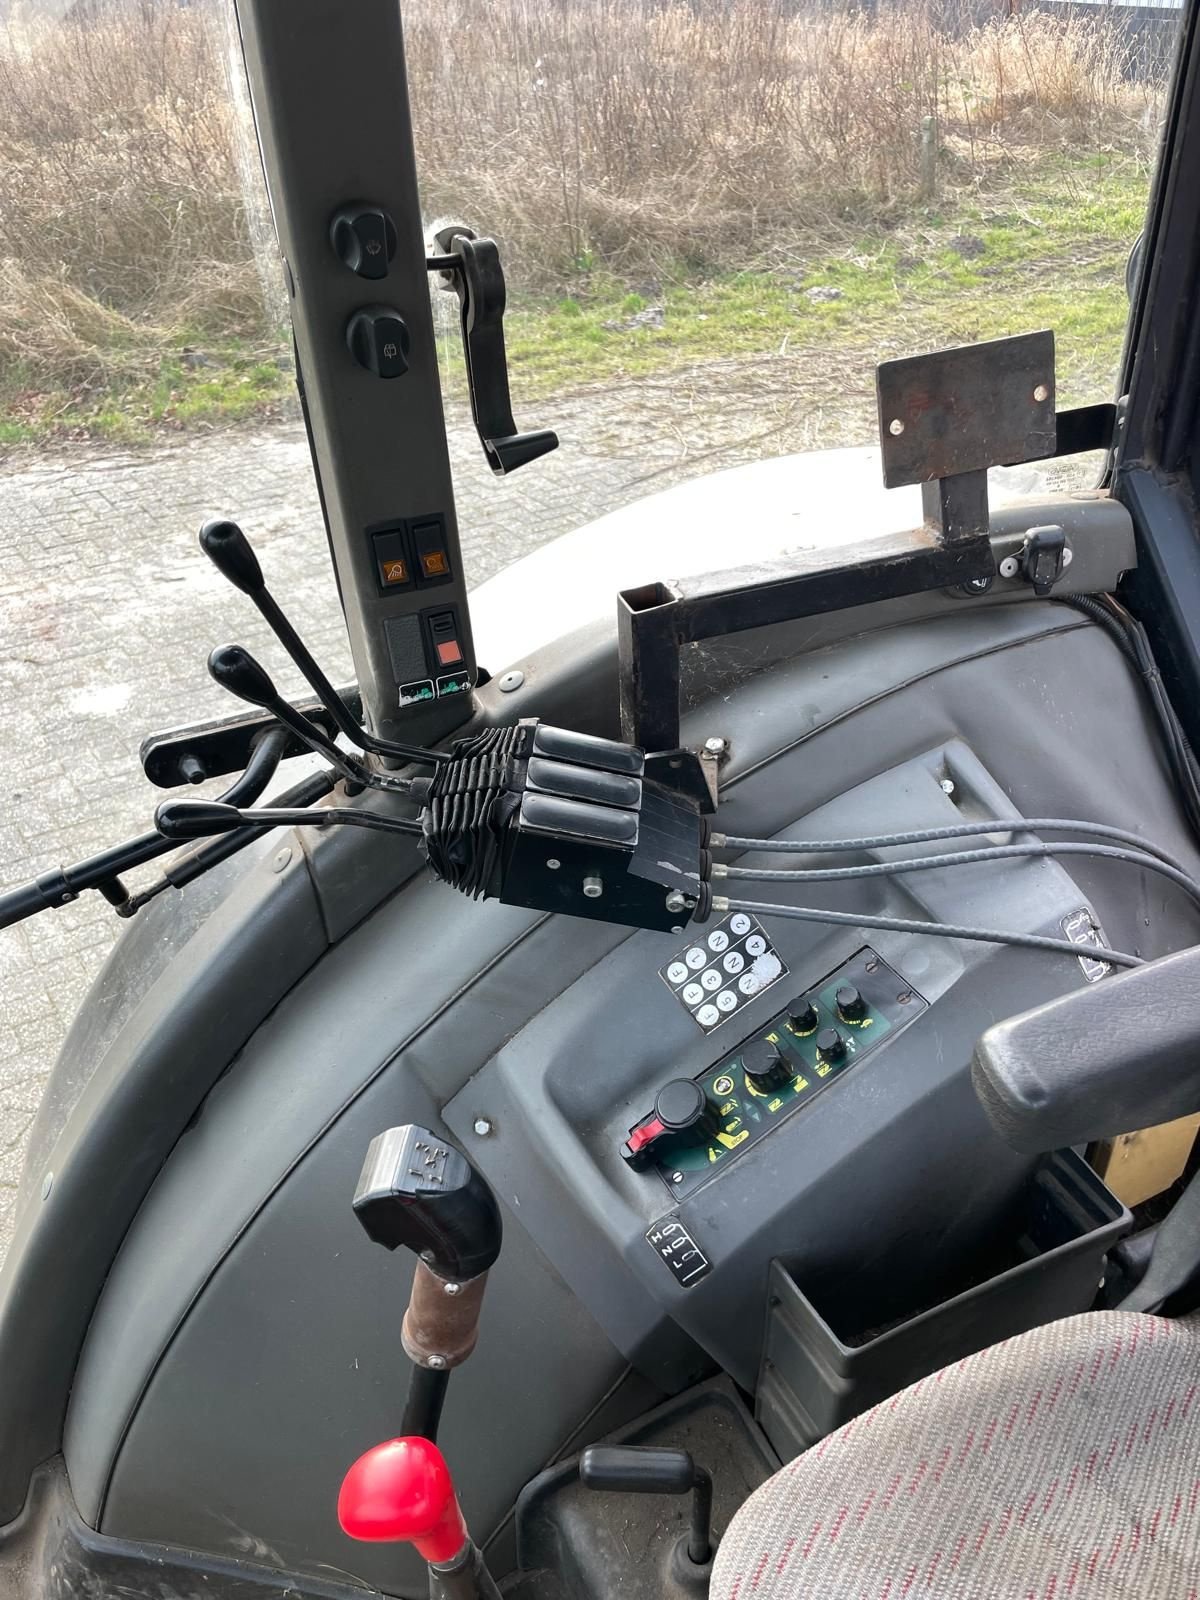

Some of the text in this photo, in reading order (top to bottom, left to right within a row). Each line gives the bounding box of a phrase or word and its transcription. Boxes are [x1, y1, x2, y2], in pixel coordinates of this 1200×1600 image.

[736, 919, 746, 928] 2
[712, 936, 725, 947] N
[751, 941, 760, 949] 4
[691, 954, 700, 963] 1
[728, 957, 740, 969] N
[672, 969, 683, 978] F
[706, 976, 717, 984] 3
[688, 991, 699, 999] F
[721, 997, 732, 1006] 5
[651, 1232, 662, 1243] H
[661, 1245, 673, 1257] N
[673, 1261, 683, 1269] L
